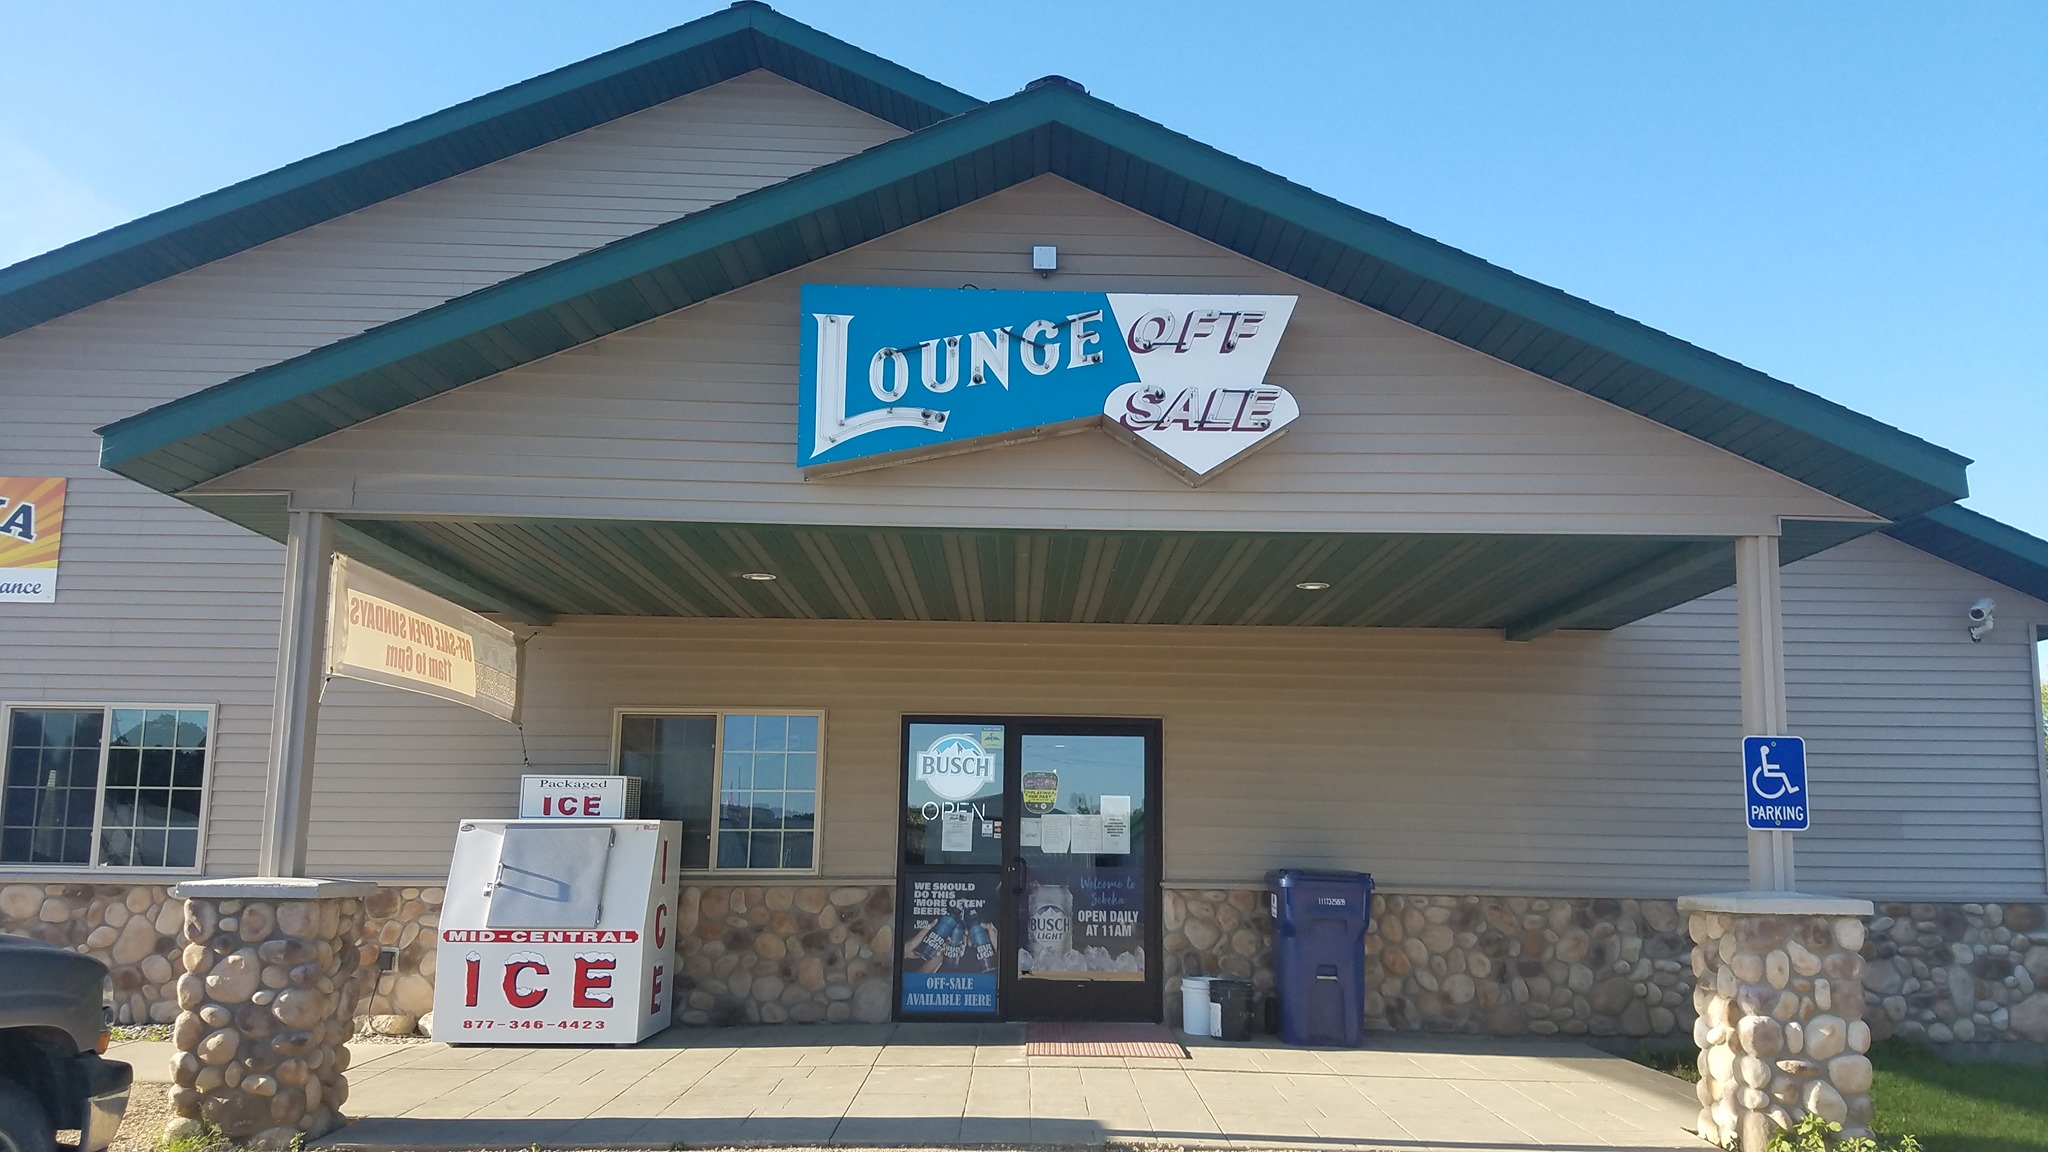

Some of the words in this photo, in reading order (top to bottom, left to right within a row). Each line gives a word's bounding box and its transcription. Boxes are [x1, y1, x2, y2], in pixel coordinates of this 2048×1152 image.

[1127, 308, 1267, 354] OFF
[809, 309, 1104, 459] LOUNGE
[1119, 384, 1282, 432] SALE
[0, 497, 36, 543] A
[922, 755, 989, 777] BUSCH
[539, 779, 607, 791] Packaged
[542, 794, 602, 816] ICE
[921, 801, 986, 821] OPEN
[1751, 805, 1804, 821] PARKING
[914, 882, 932, 891] WE
[932, 882, 976, 891] SHOULD
[1079, 876, 1124, 890] Welcome
[1126, 876, 1136, 890] to
[914, 890, 931, 899] DO
[931, 890, 956, 899] THIS
[913, 907, 950, 916] BEERS.
[1077, 910, 1107, 922] OPEN
[1109, 910, 1139, 923] DAILY
[1030, 917, 1070, 933] BUSCH
[1085, 924, 1099, 937] AT
[1101, 924, 1132, 937] 11AM
[448, 930, 634, 943] MID-CENTRAL
[928, 932, 945, 946] BUD
[1037, 932, 1064, 940] LIGHT
[464, 950, 617, 1009] ICE
[926, 977, 974, 990] OFF-SALE
[906, 993, 962, 1007] AVAILABLE
[964, 994, 992, 1007] HERE
[462, 1020, 606, 1029] 877-346-4423
